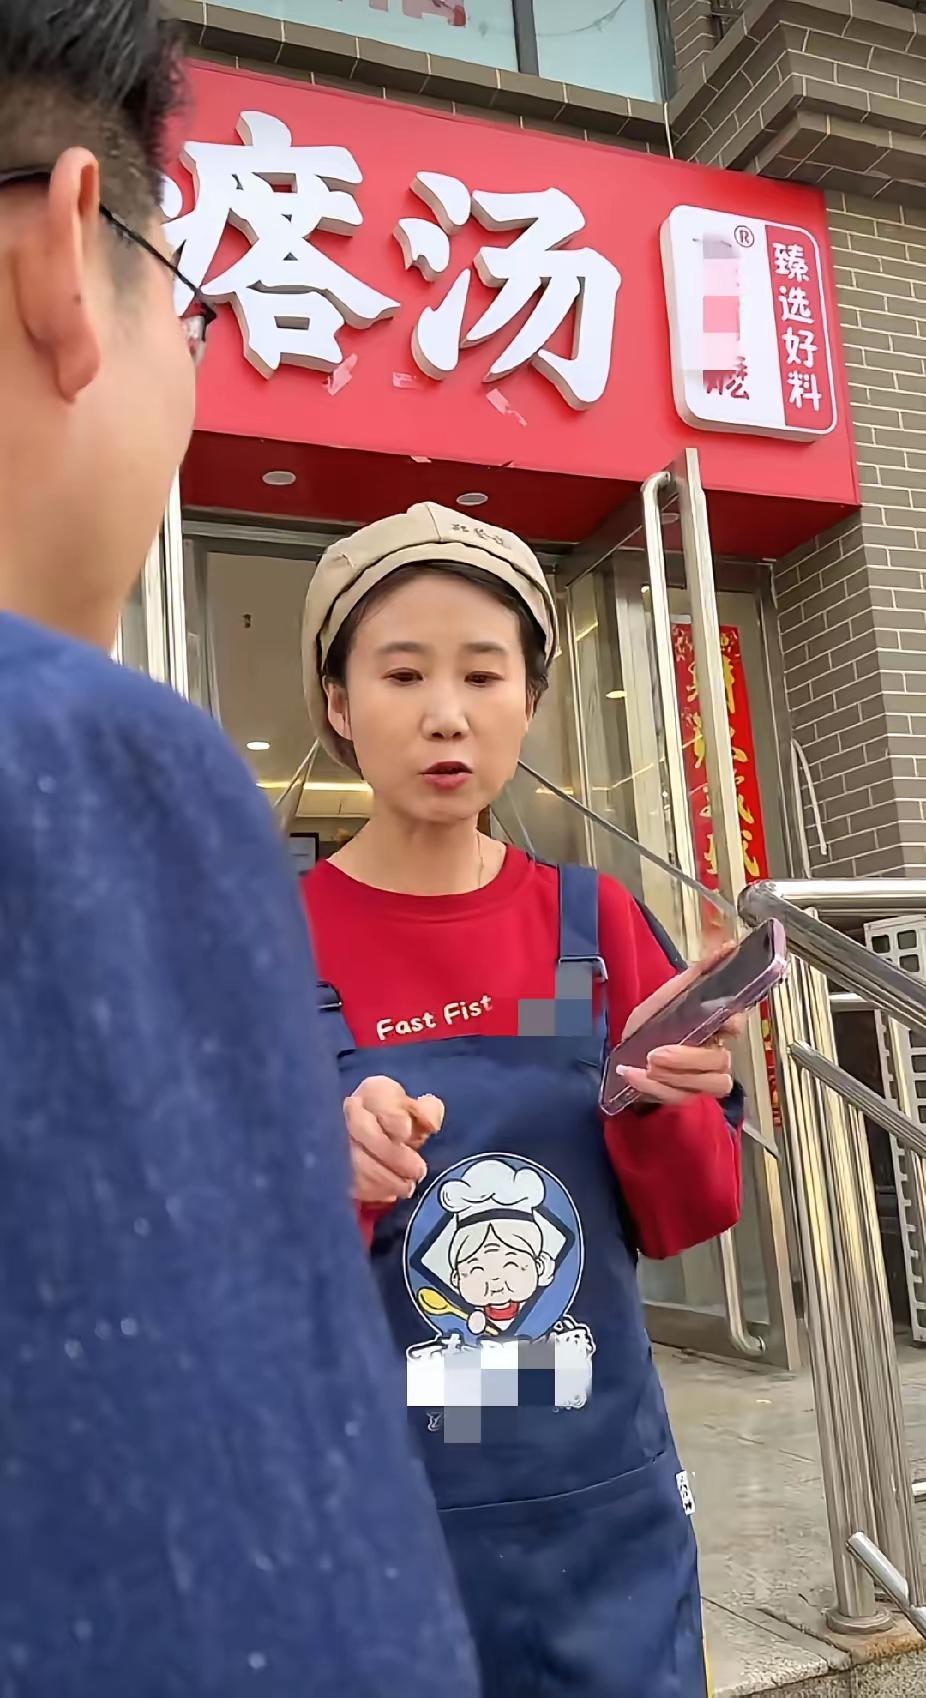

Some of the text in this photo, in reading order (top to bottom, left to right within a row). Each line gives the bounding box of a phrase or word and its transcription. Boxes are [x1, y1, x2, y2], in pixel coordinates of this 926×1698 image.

[772, 241, 822, 412] 臻选好料
[376, 995, 493, 1041] Fast Fist
